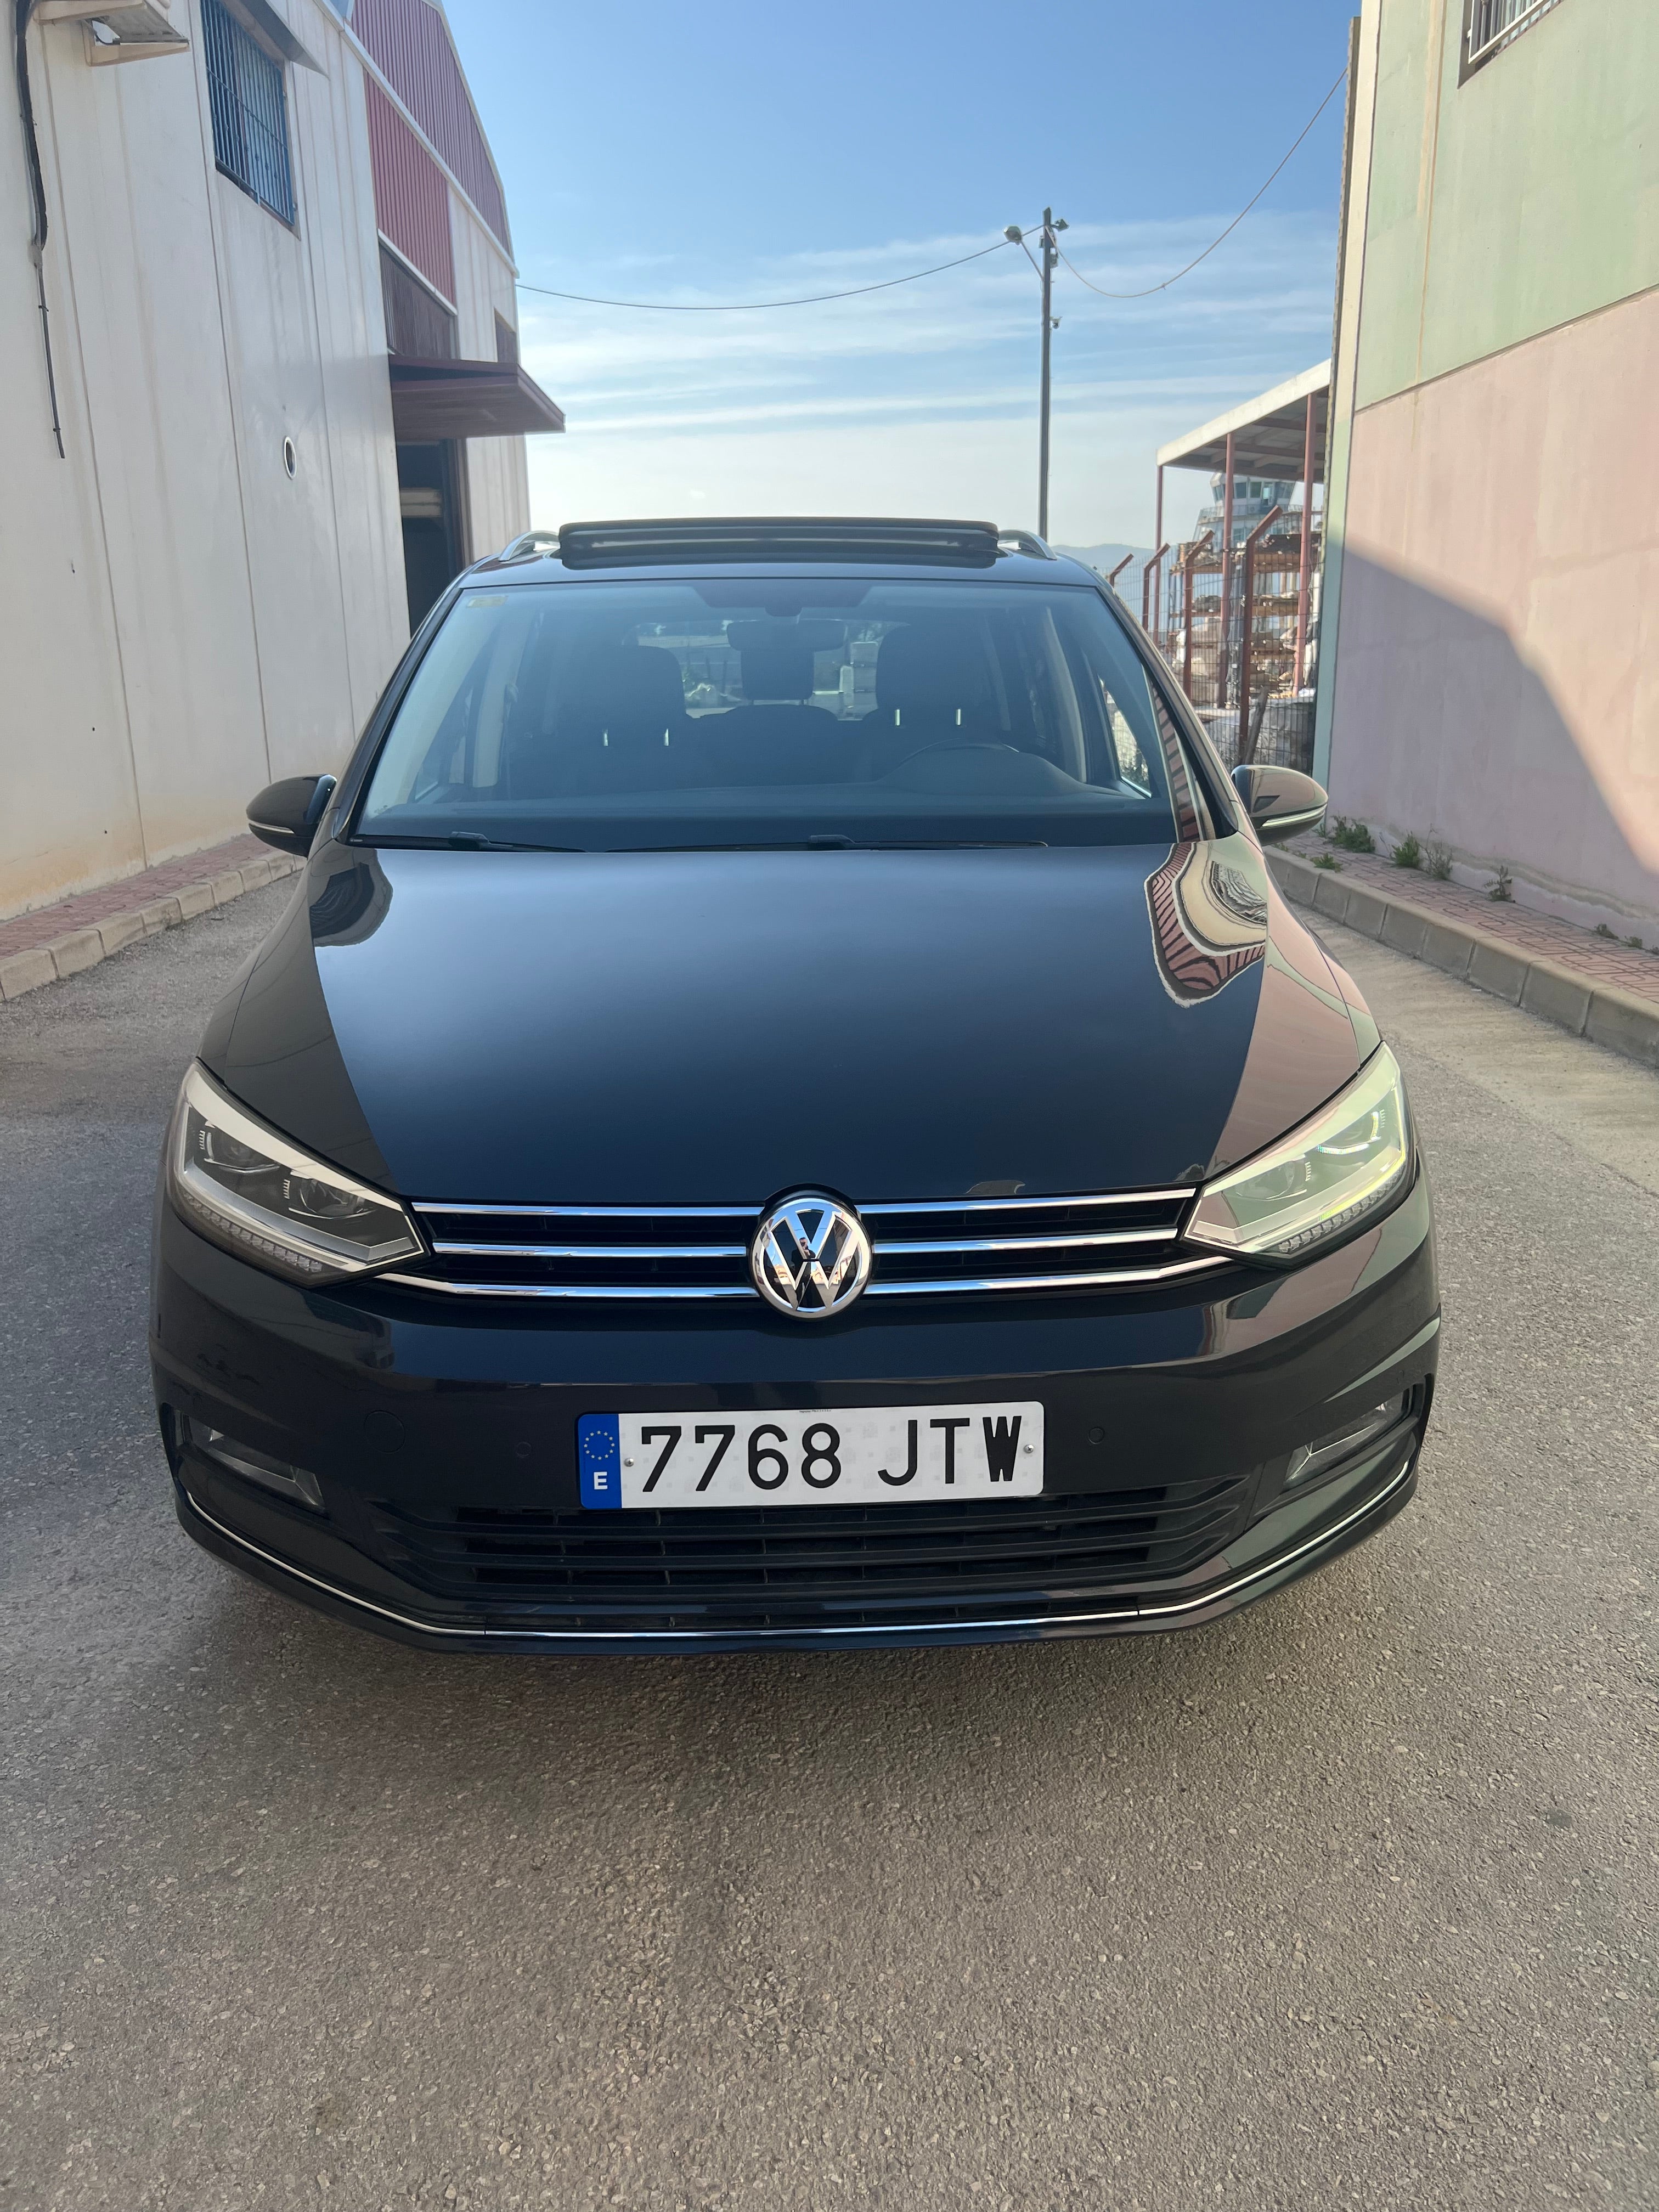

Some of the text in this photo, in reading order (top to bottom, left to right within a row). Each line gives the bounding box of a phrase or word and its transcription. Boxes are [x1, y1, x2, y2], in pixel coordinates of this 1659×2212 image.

[753, 1199, 871, 1318] VW
[594, 1471, 608, 1490] E
[641, 1415, 1023, 1492] 7768 JTW
